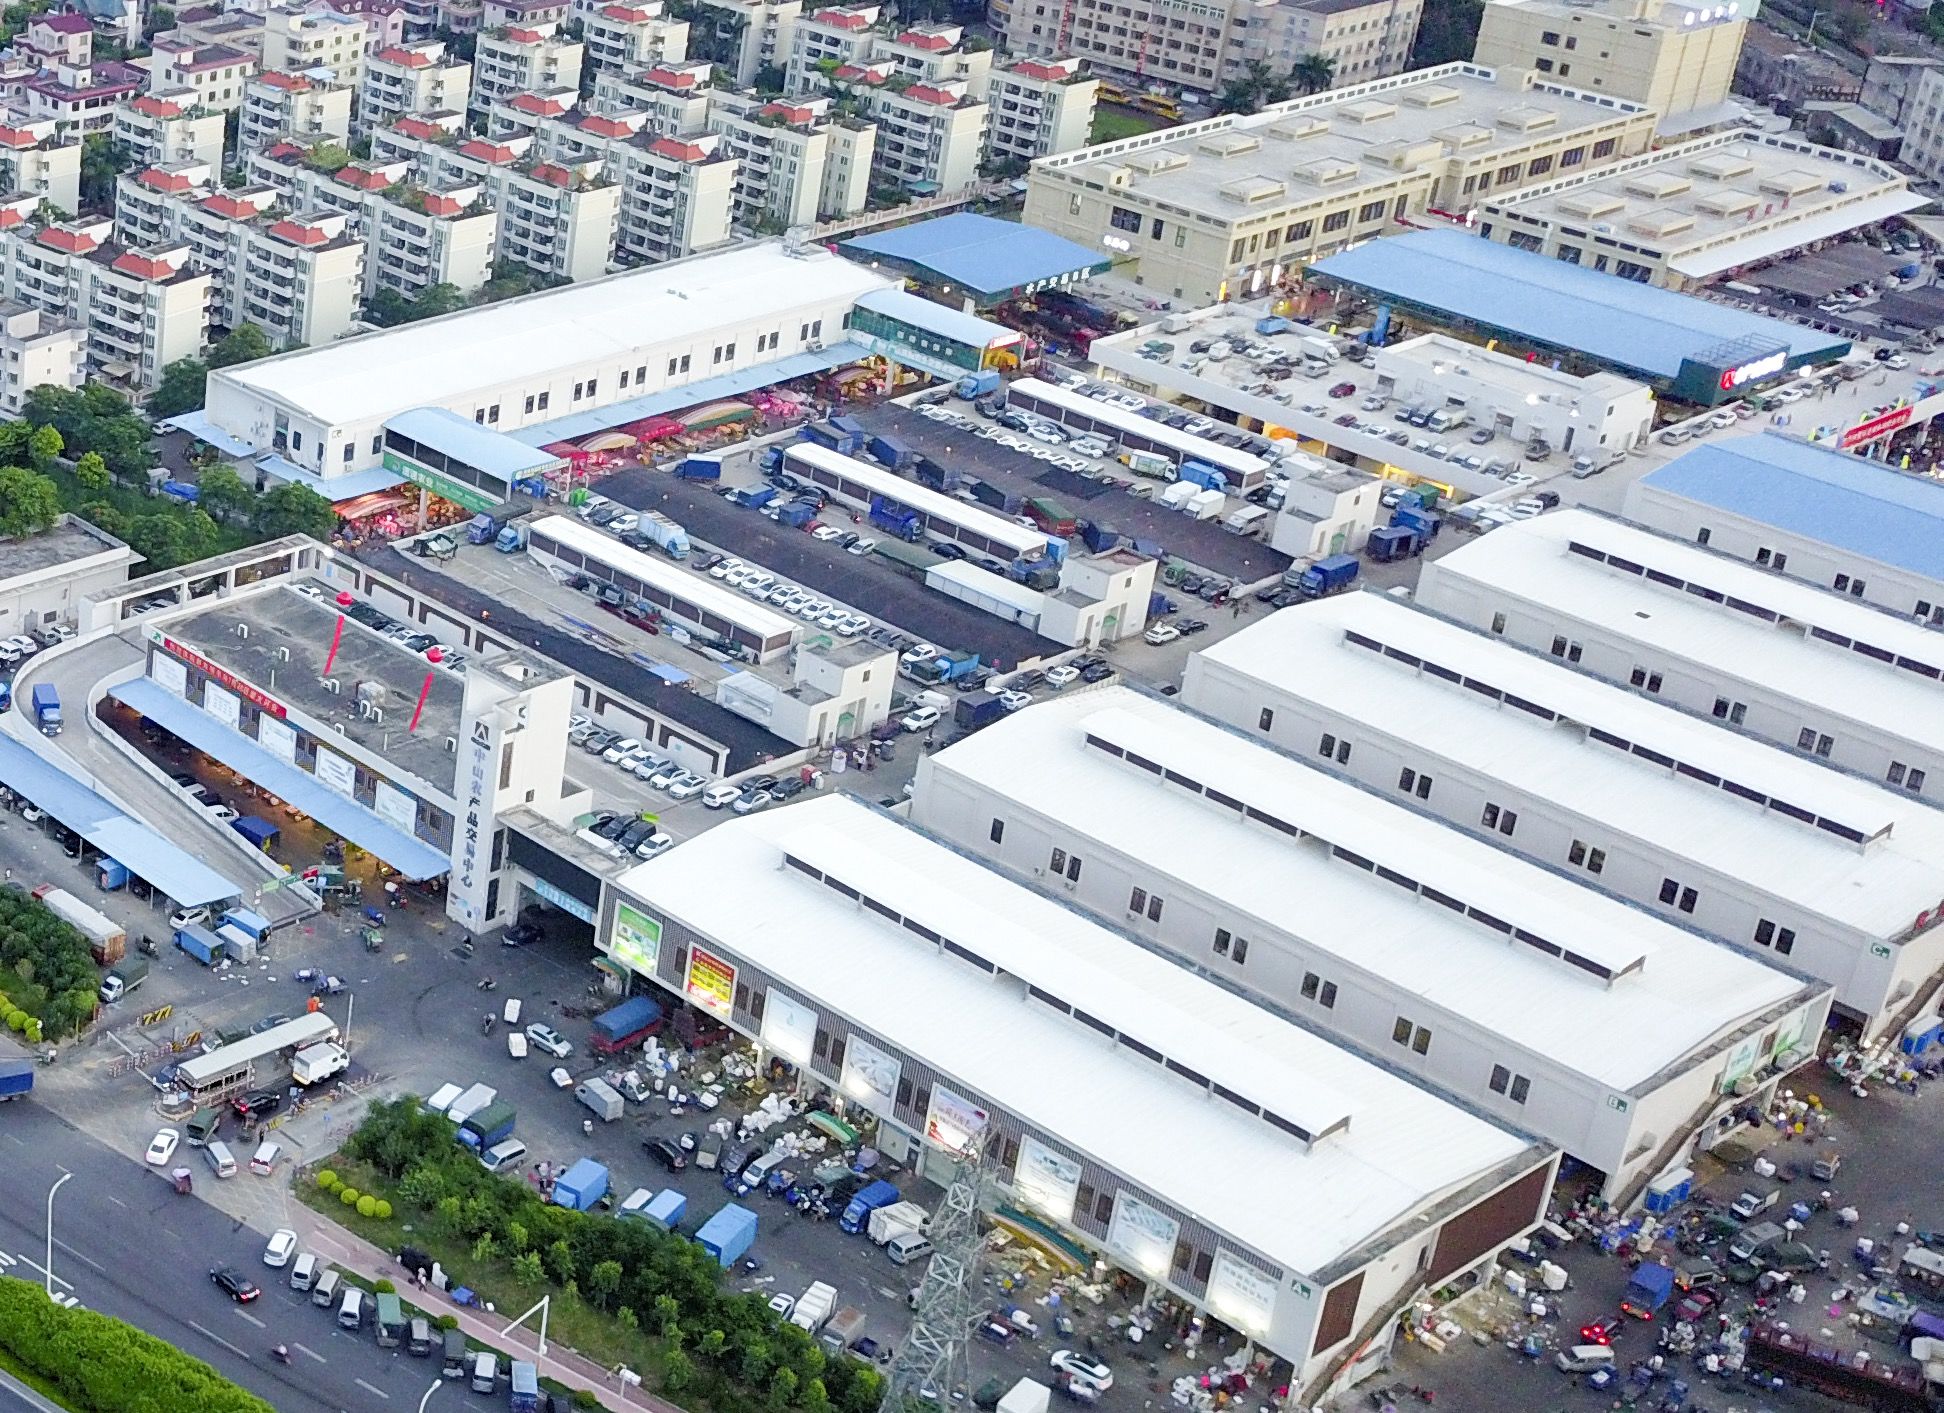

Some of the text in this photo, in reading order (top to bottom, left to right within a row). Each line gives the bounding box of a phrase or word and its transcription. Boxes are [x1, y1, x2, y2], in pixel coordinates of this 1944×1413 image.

[460, 748, 486, 889] 中山农产品交易中心
